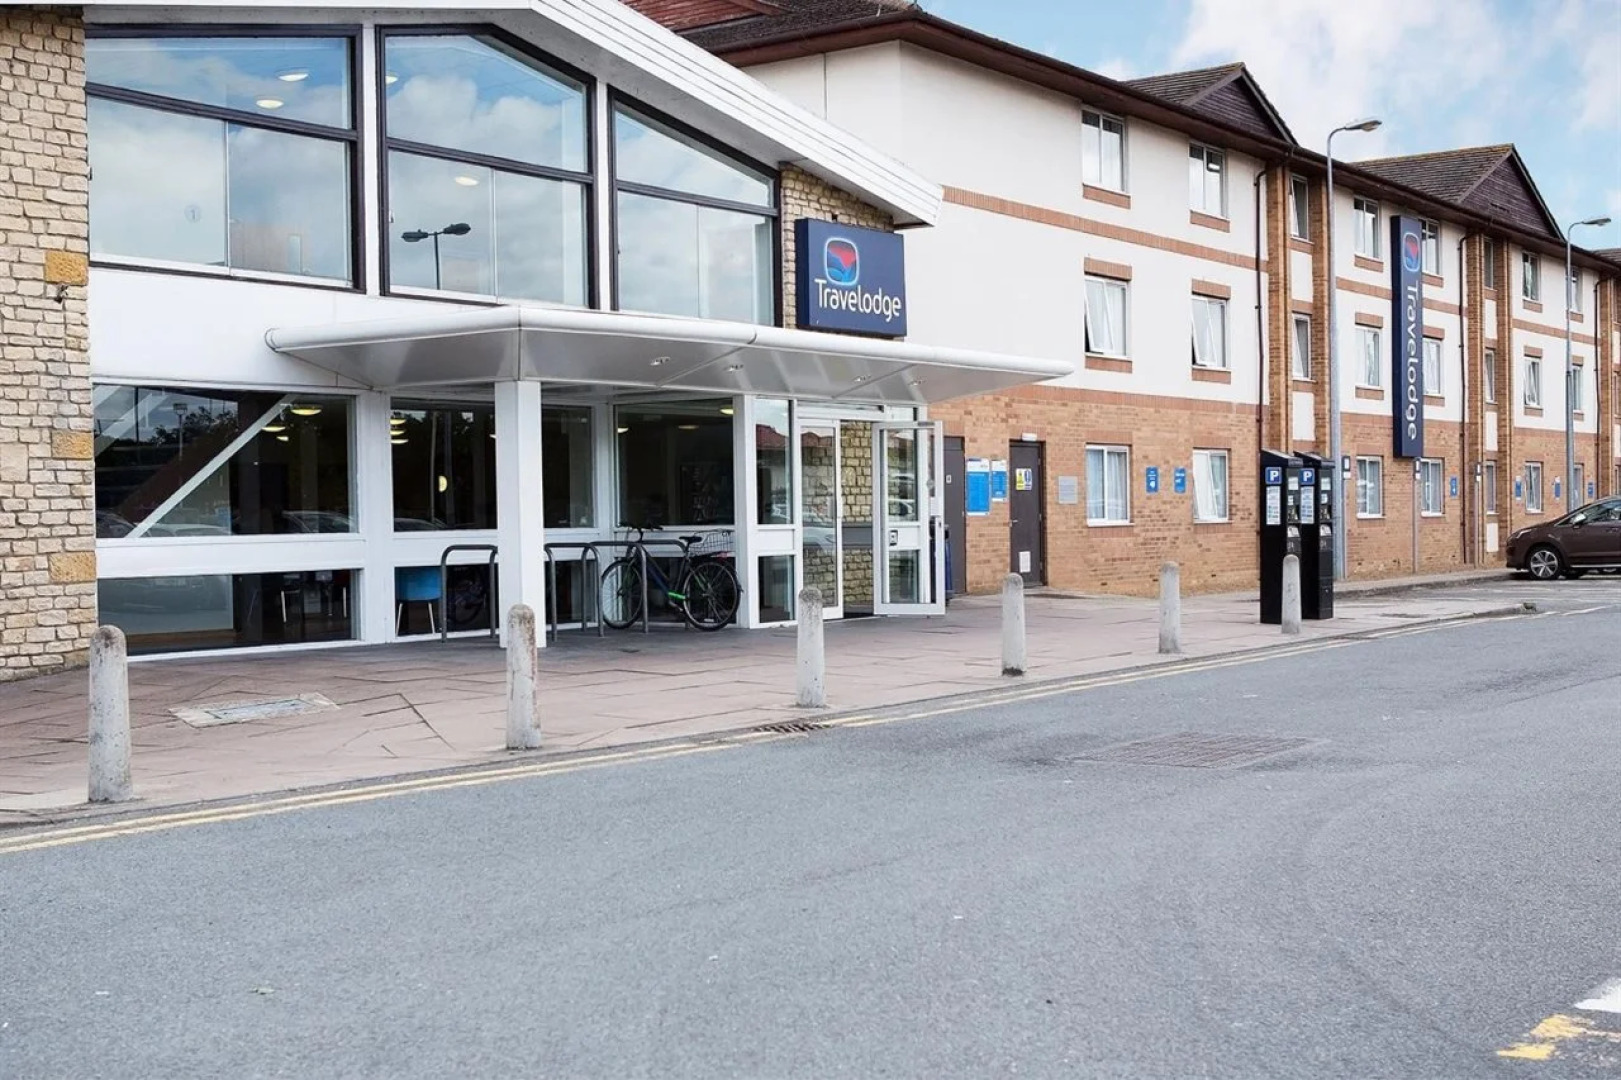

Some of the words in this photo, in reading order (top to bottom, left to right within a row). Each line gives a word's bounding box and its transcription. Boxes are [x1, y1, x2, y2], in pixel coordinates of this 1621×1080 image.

[814, 278, 902, 322] Travelodge
[1405, 280, 1419, 441] Travelodge
[1269, 470, 1279, 482] P
[1303, 470, 1313, 482] P
